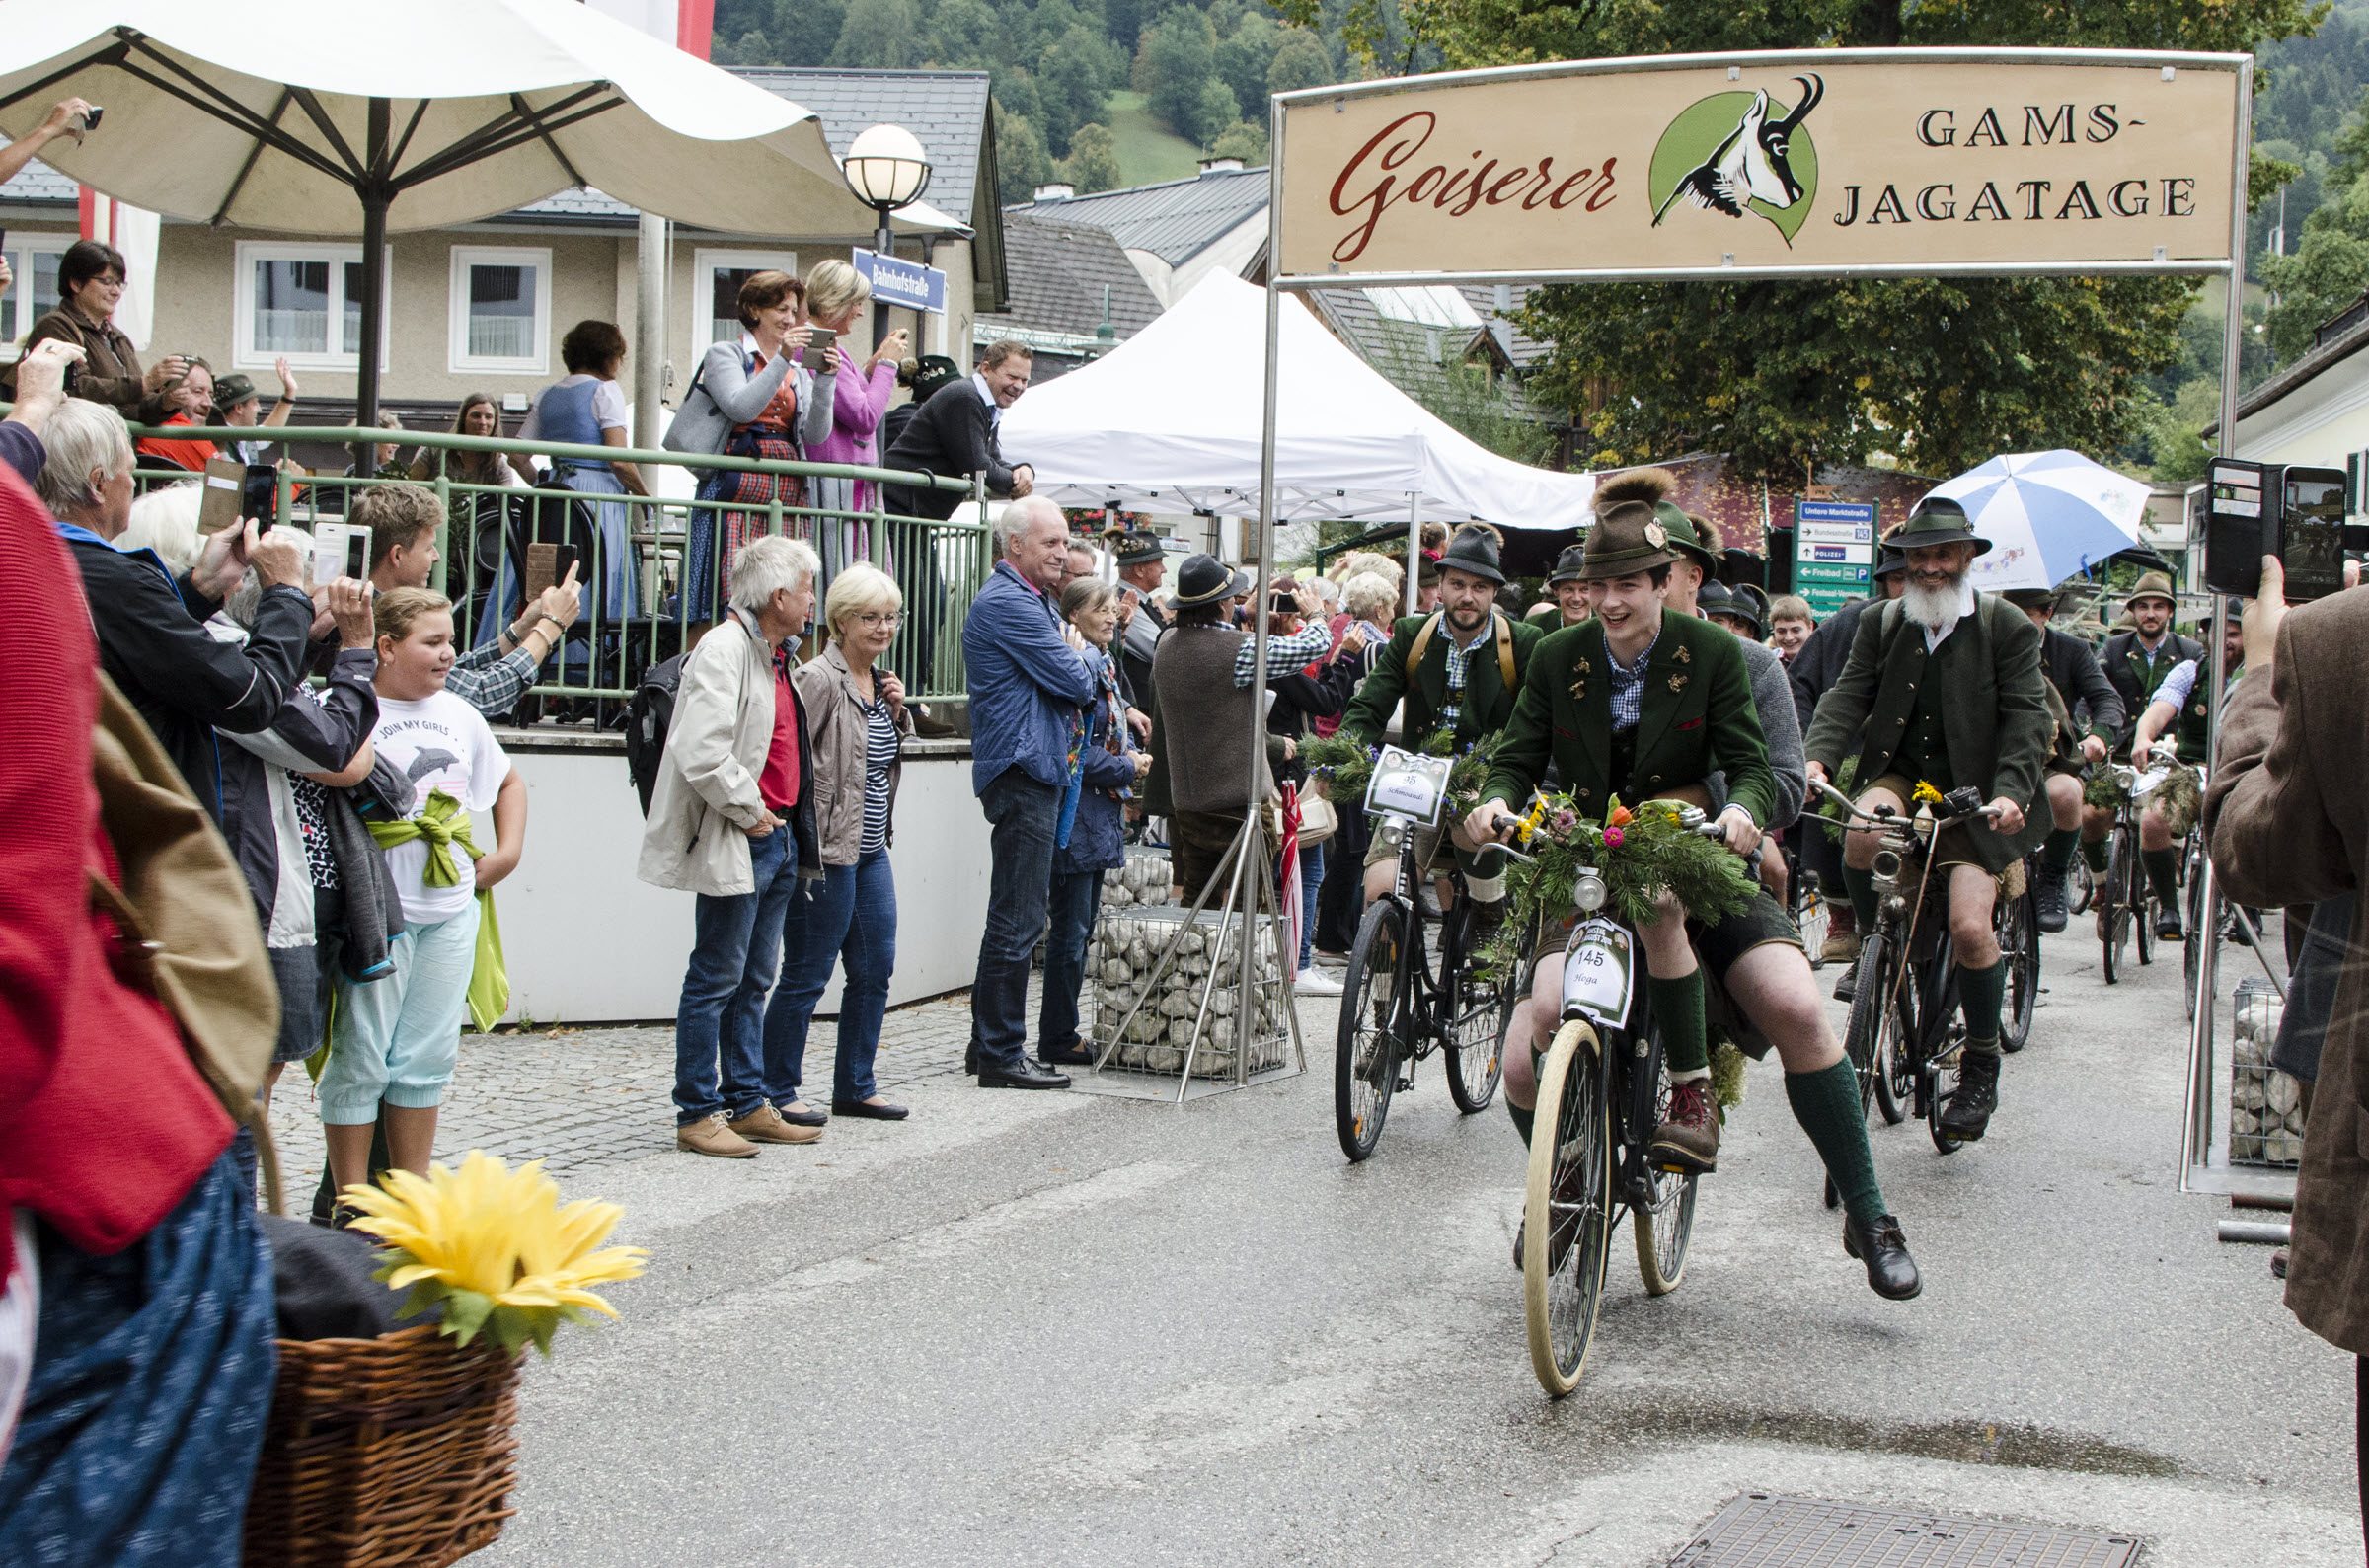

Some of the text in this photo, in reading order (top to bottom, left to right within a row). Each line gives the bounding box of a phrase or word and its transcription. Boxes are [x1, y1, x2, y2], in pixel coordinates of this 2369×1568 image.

[1916, 104, 2149, 147] GAMS-
[1330, 111, 1617, 262] Goiserer
[1833, 178, 2196, 227] JAGATAGE
[873, 263, 929, 298] Bahnhofstraße
[1804, 507, 1869, 517] Untere Marktstraße
[1812, 568, 1841, 577] Freibad
[379, 719, 450, 740] JOIN MY GIRLS
[1578, 950, 1605, 966] 145
[1573, 974, 1598, 984] Hoga
